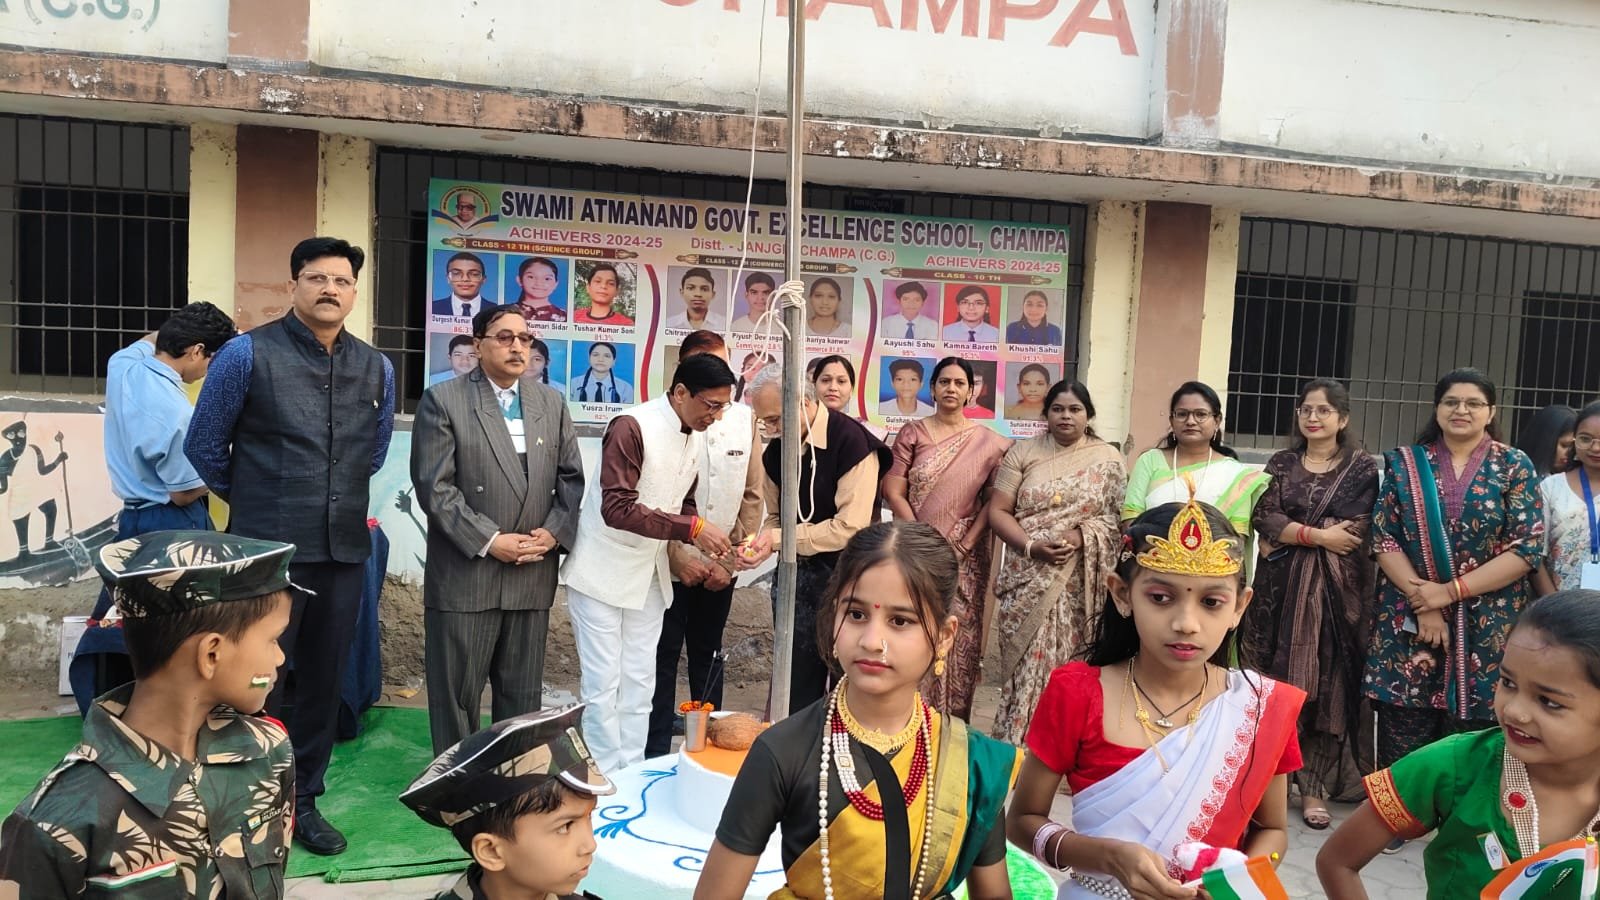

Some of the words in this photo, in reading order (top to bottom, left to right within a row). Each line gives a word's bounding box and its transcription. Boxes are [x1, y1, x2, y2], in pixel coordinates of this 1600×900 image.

[501, 190, 574, 221] SWAMI
[580, 197, 698, 230] ATMANAND
[704, 206, 762, 235] GOVT.
[901, 218, 984, 254] SCHOOL,
[990, 226, 1067, 254] CHAMPA
[509, 226, 601, 244] ACHIEVERS
[606, 234, 663, 249] 2024-25
[472, 240, 499, 249] CLASS
[519, 243, 530, 251] TH
[532, 244, 572, 254] (SCIENCE
[573, 248, 604, 257] GROUP)
[691, 237, 725, 250] Distt.
[859, 250, 896, 265] (C.G.)
[926, 255, 1006, 271] ACHIEVERS
[1010, 260, 1062, 273] 2024-25
[934, 271, 966, 279] CLASS
[551, 323, 569, 331] Sidar
[574, 324, 596, 332] Tushar
[598, 326, 619, 334] Kumar
[884, 339, 914, 348] Aayushi
[916, 340, 936, 348] Sahu
[943, 342, 970, 350] Kamna
[971, 342, 998, 351] Bareth
[1009, 344, 1036, 353] Khushi
[1038, 345, 1058, 354] Sahu
[581, 403, 603, 412] Yusra
[605, 404, 623, 413] Irum
